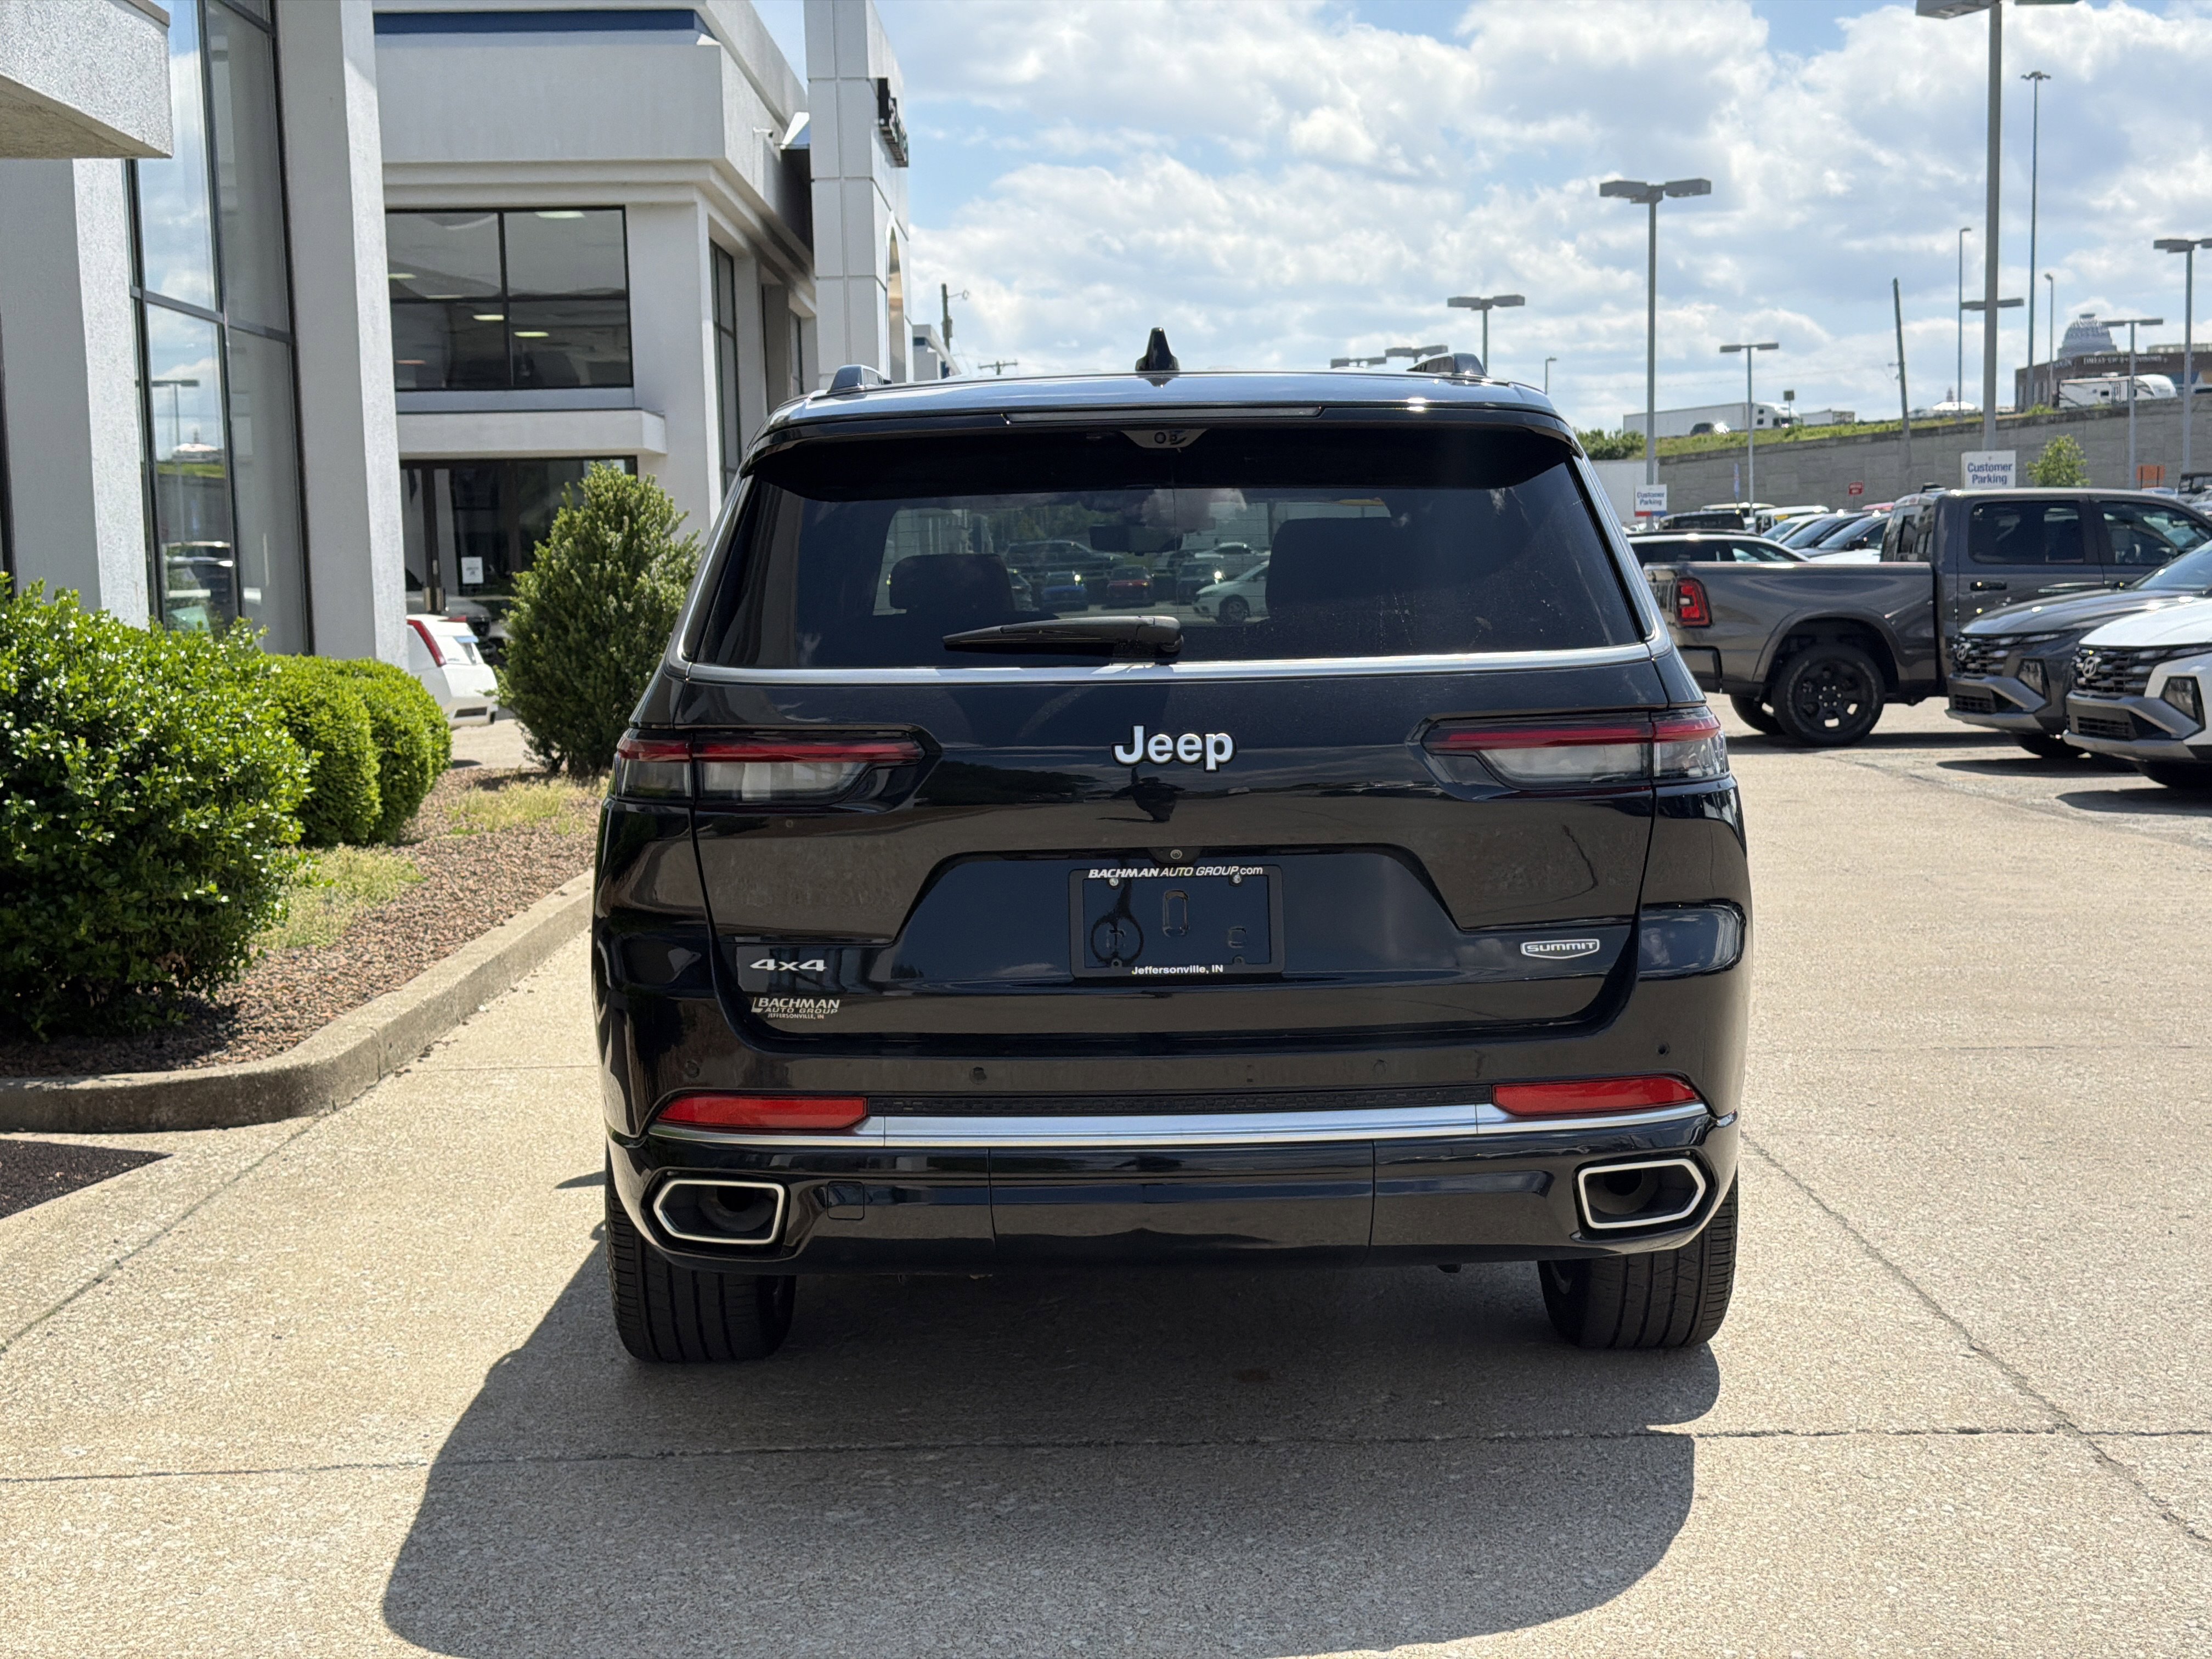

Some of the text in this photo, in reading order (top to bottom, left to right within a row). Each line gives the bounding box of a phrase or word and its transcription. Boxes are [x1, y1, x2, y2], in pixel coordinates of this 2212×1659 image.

[1967, 462, 2012, 472] Customer
[1972, 473, 2007, 485] Parking
[1114, 725, 1234, 771] Jeep
[1089, 868, 1159, 878] BACHMAN
[1159, 867, 1193, 877] AUTO
[1527, 942, 1595, 952] SUMMIT
[749, 958, 828, 972] 4x4
[1132, 964, 1223, 975] Jeffersonville, IN
[758, 997, 840, 1009] BACHMAN
